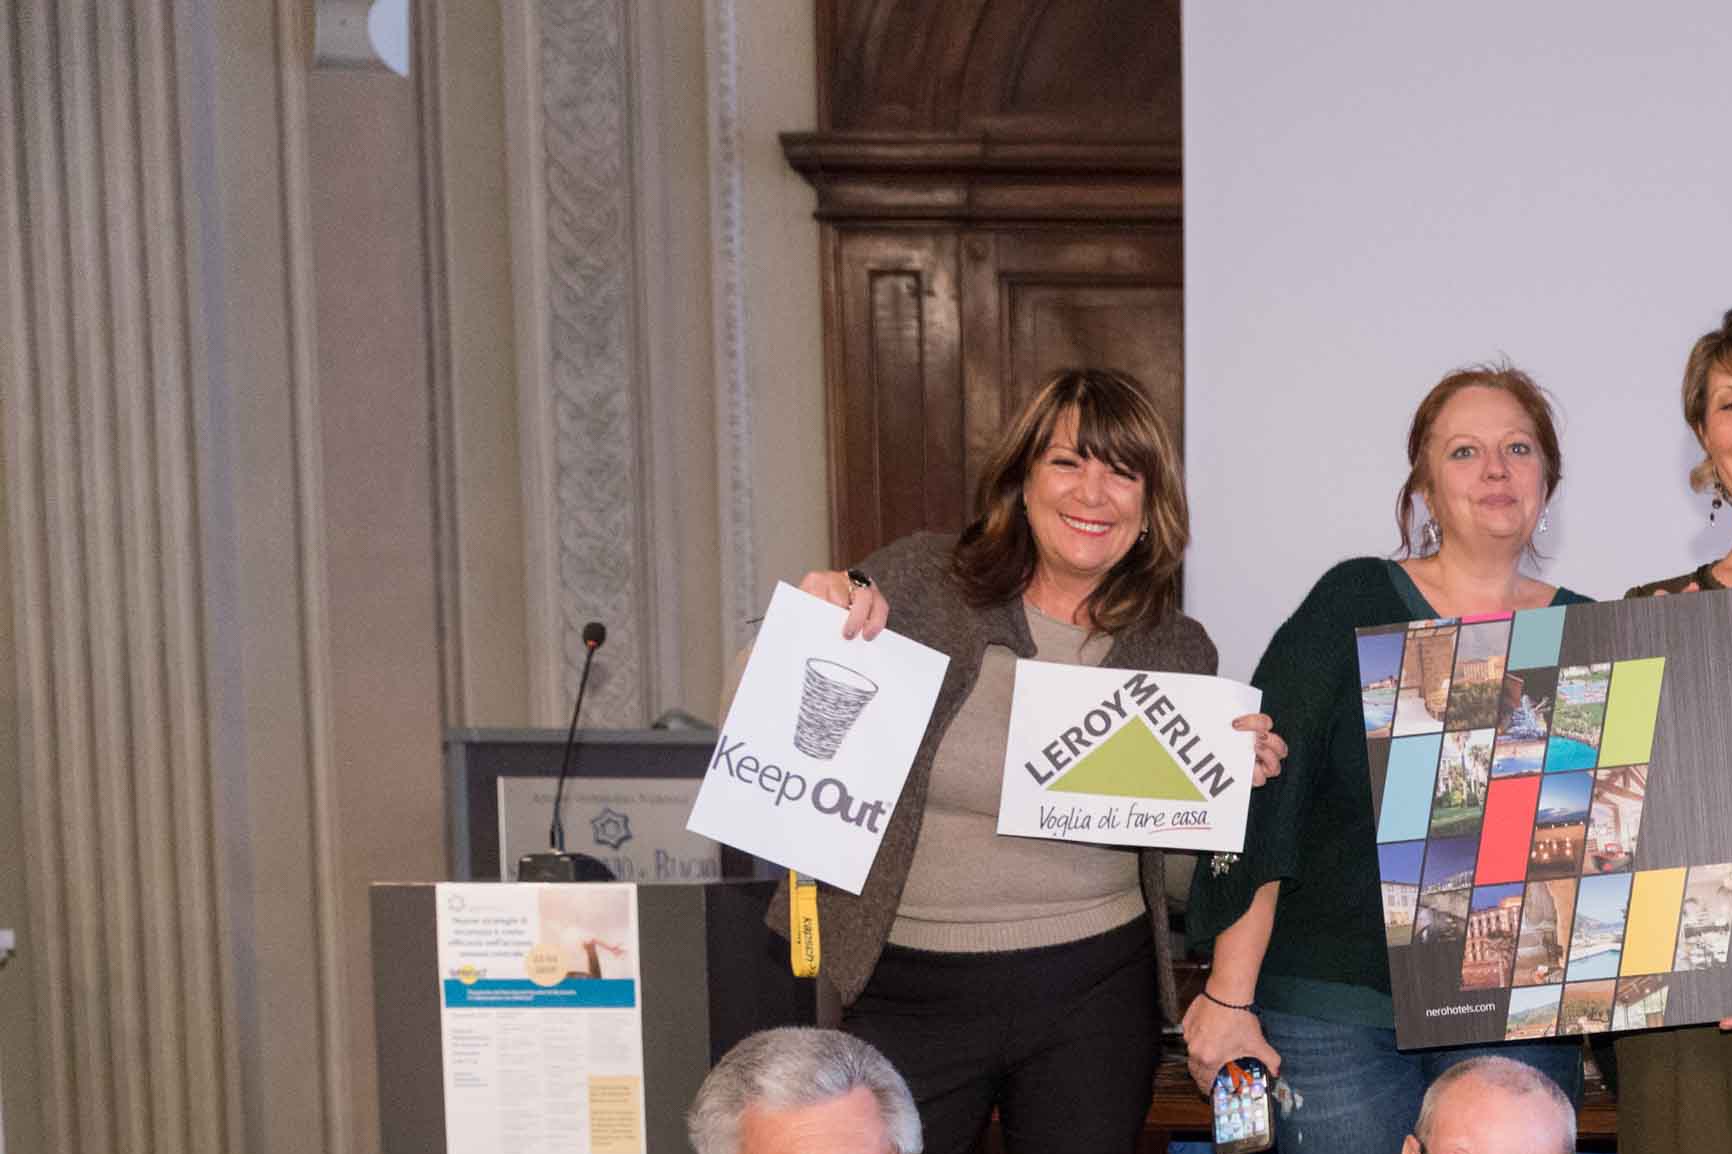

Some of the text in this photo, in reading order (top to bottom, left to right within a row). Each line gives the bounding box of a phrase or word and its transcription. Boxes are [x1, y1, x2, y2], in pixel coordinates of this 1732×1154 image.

[1025, 689, 1129, 786] LEROY
[1123, 672, 1235, 799] MERLIN
[712, 735, 886, 834] Keep Out
[1039, 804, 1208, 837] Voglia di fare casa
[1425, 1002, 1496, 1017] nerohotels.com
